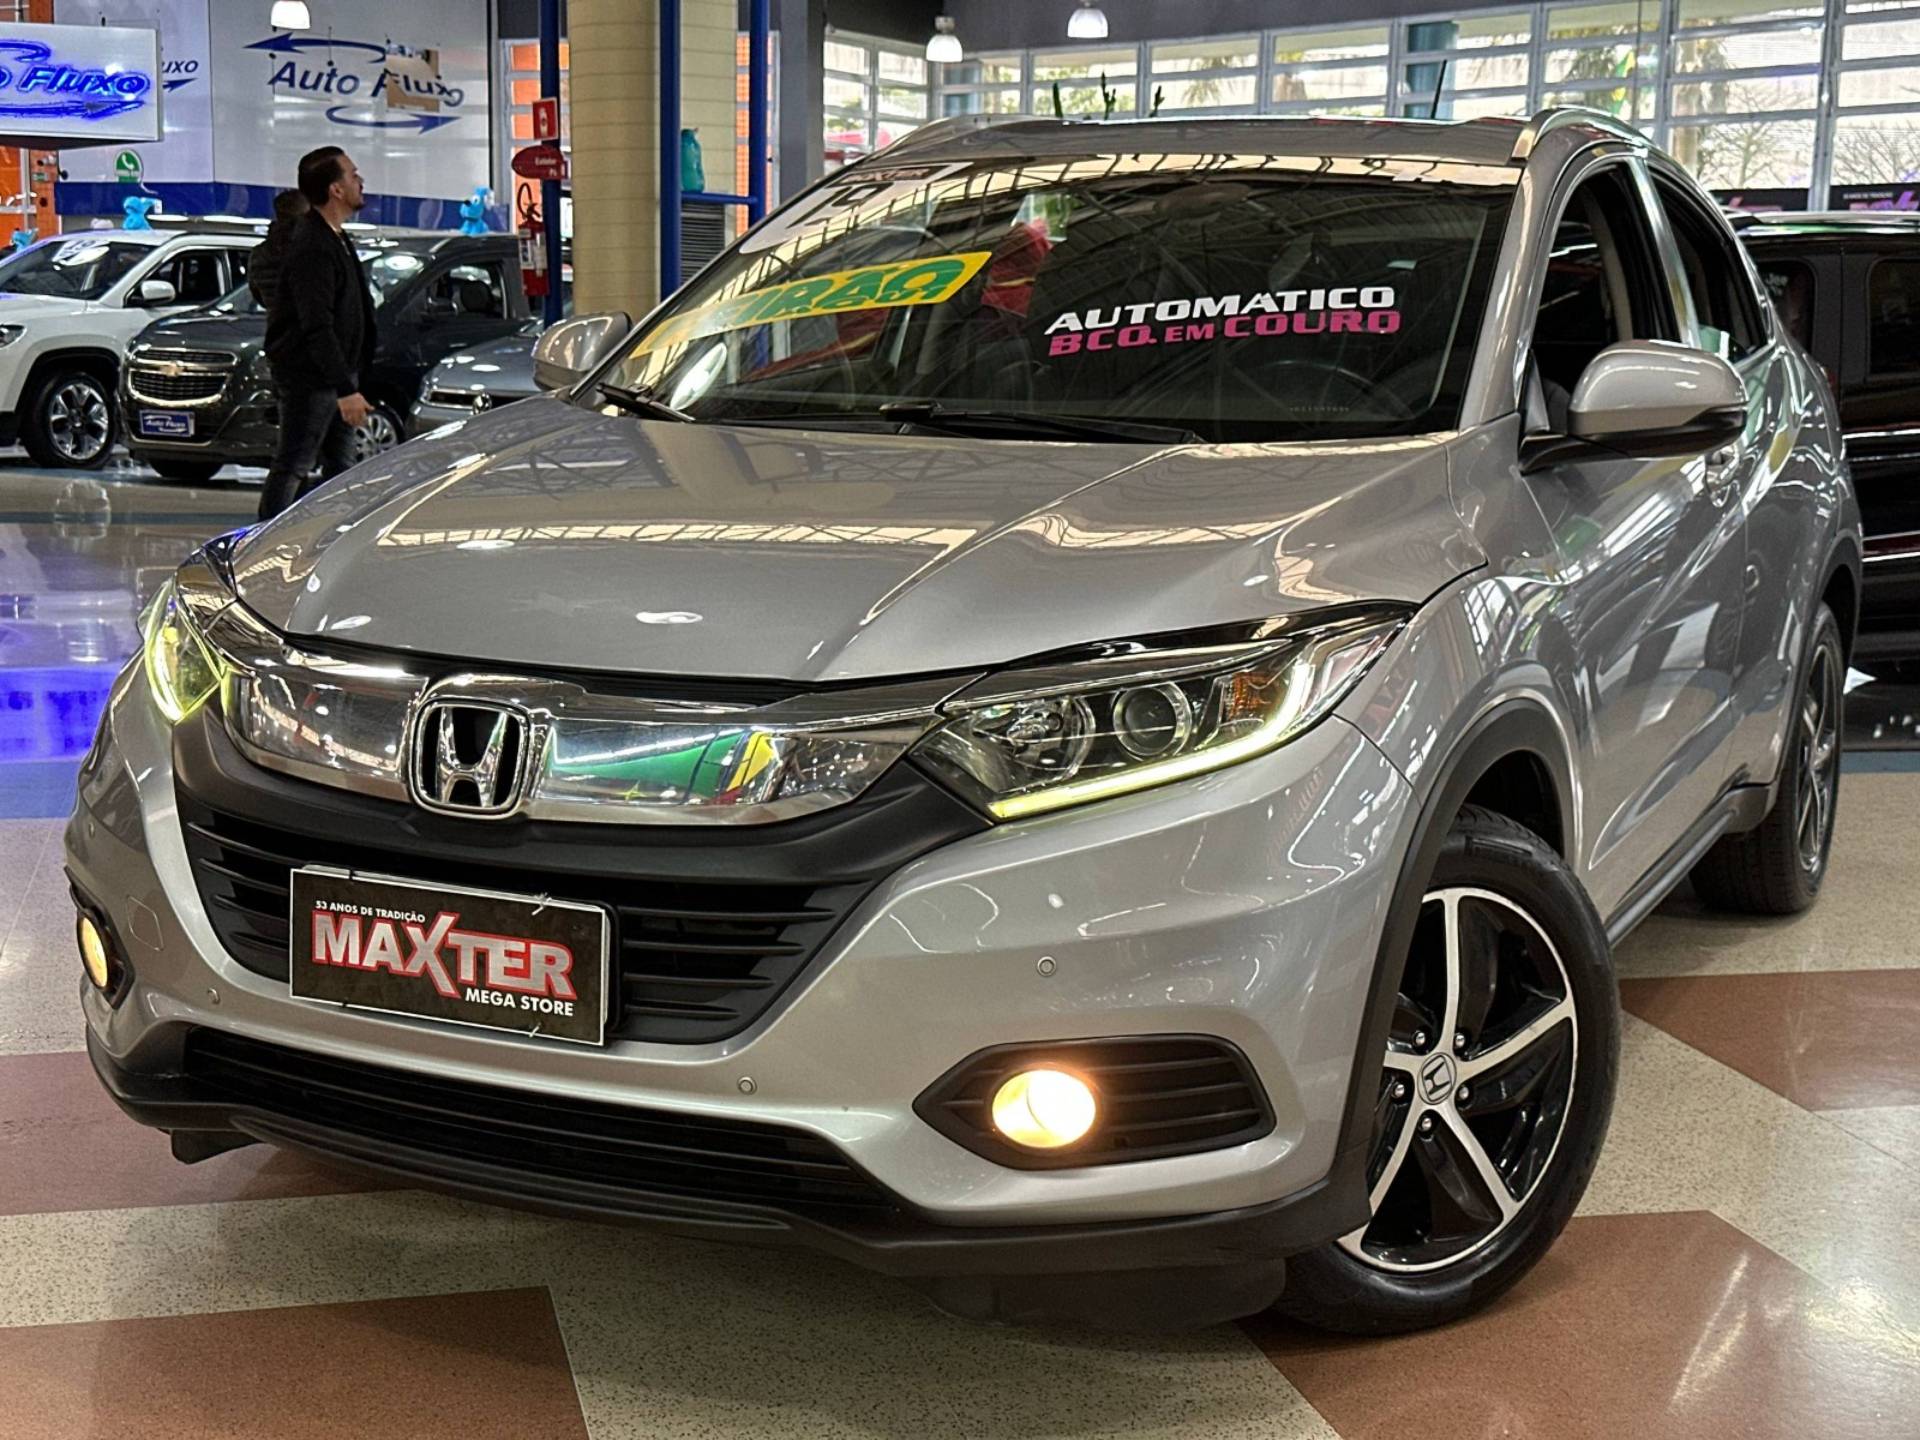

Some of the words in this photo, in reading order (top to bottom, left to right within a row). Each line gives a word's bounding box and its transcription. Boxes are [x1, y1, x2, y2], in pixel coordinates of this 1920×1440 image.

[18, 64, 149, 97] Fluxo
[268, 61, 359, 95] Auto
[371, 68, 464, 107] Fluxo
[1164, 323, 1214, 341] EM
[1224, 310, 1401, 338] COURO
[315, 900, 327, 910] 53
[330, 902, 358, 914] ANOS
[360, 906, 373, 916] DE
[375, 908, 426, 923] TRADIÇÃO
[312, 911, 577, 1000] MAXTER
[465, 987, 516, 1009] MEGA
[520, 995, 574, 1017] STORE
